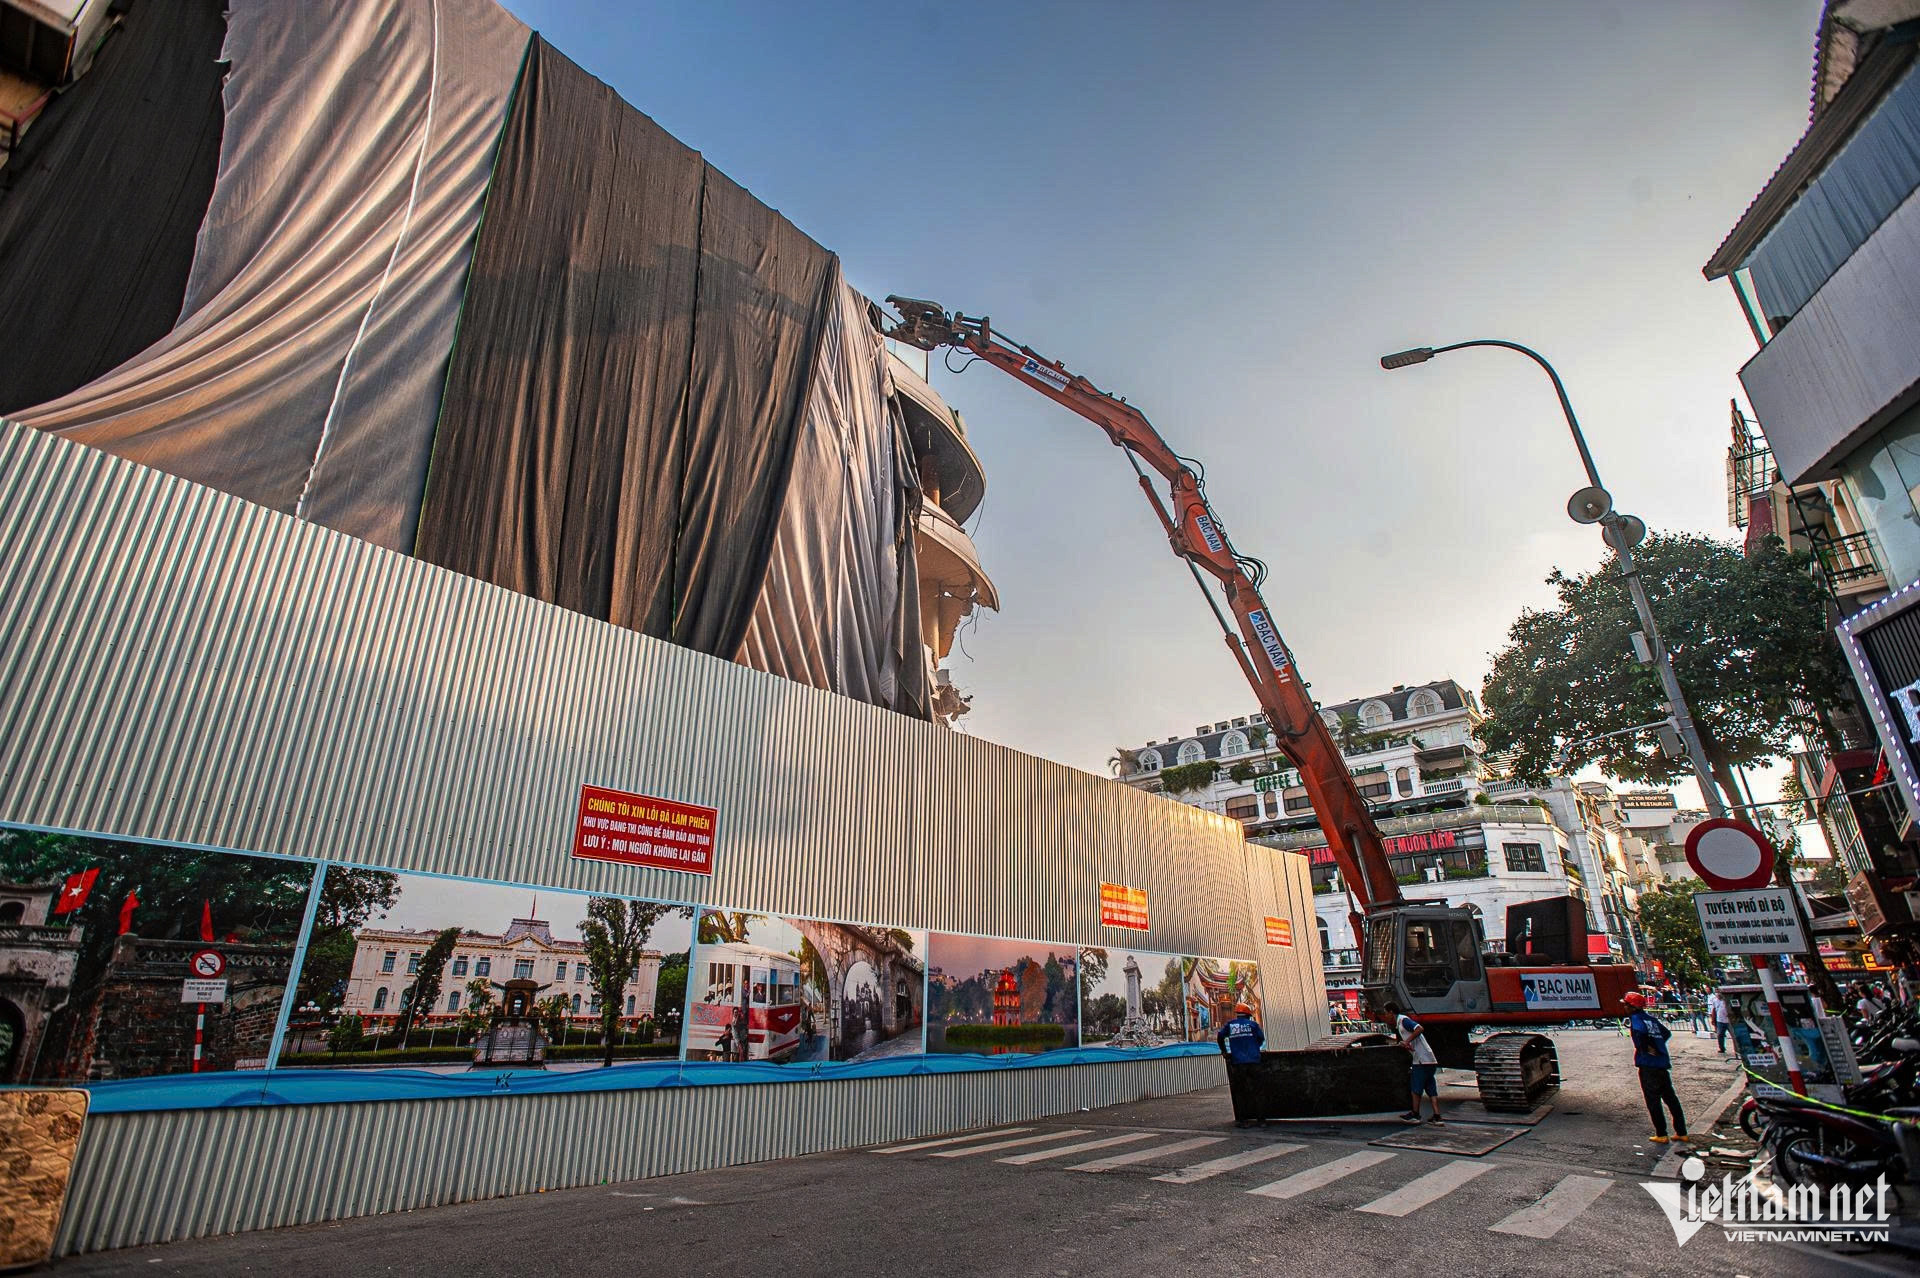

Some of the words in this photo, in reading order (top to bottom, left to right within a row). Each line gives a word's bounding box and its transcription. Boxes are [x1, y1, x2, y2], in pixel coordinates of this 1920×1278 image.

[1197, 516, 1213, 533] BAC
[1205, 533, 1222, 552] NAM
[1256, 622, 1275, 643] BAC
[1267, 643, 1287, 667] NAM
[1254, 773, 1291, 792] COFFEE
[588, 797, 616, 814] CHÚNG
[617, 802, 629, 816] TÔI
[631, 805, 645, 819] XIN
[646, 805, 659, 821] LỖI
[672, 812, 687, 826] LÀM
[583, 816, 597, 828] KHU
[597, 817, 609, 831] VỰC
[609, 820, 626, 833] ĐANG
[627, 823, 637, 834] THI
[637, 823, 653, 836] CÔNG
[687, 833, 696, 844] AN
[1397, 832, 1428, 853] MUÔN
[599, 834, 607, 849] Ý
[612, 839, 628, 855] MỌI
[628, 841, 651, 856] NGƯỜI
[653, 844, 678, 860] KHÔNG
[679, 849, 691, 864] LẠI
[1705, 898, 1736, 915] TUYẾN
[1736, 896, 1757, 913] PHỐ
[1771, 895, 1785, 914] BỘ
[1538, 979, 1563, 995] BAC
[1565, 979, 1592, 994] NAM
